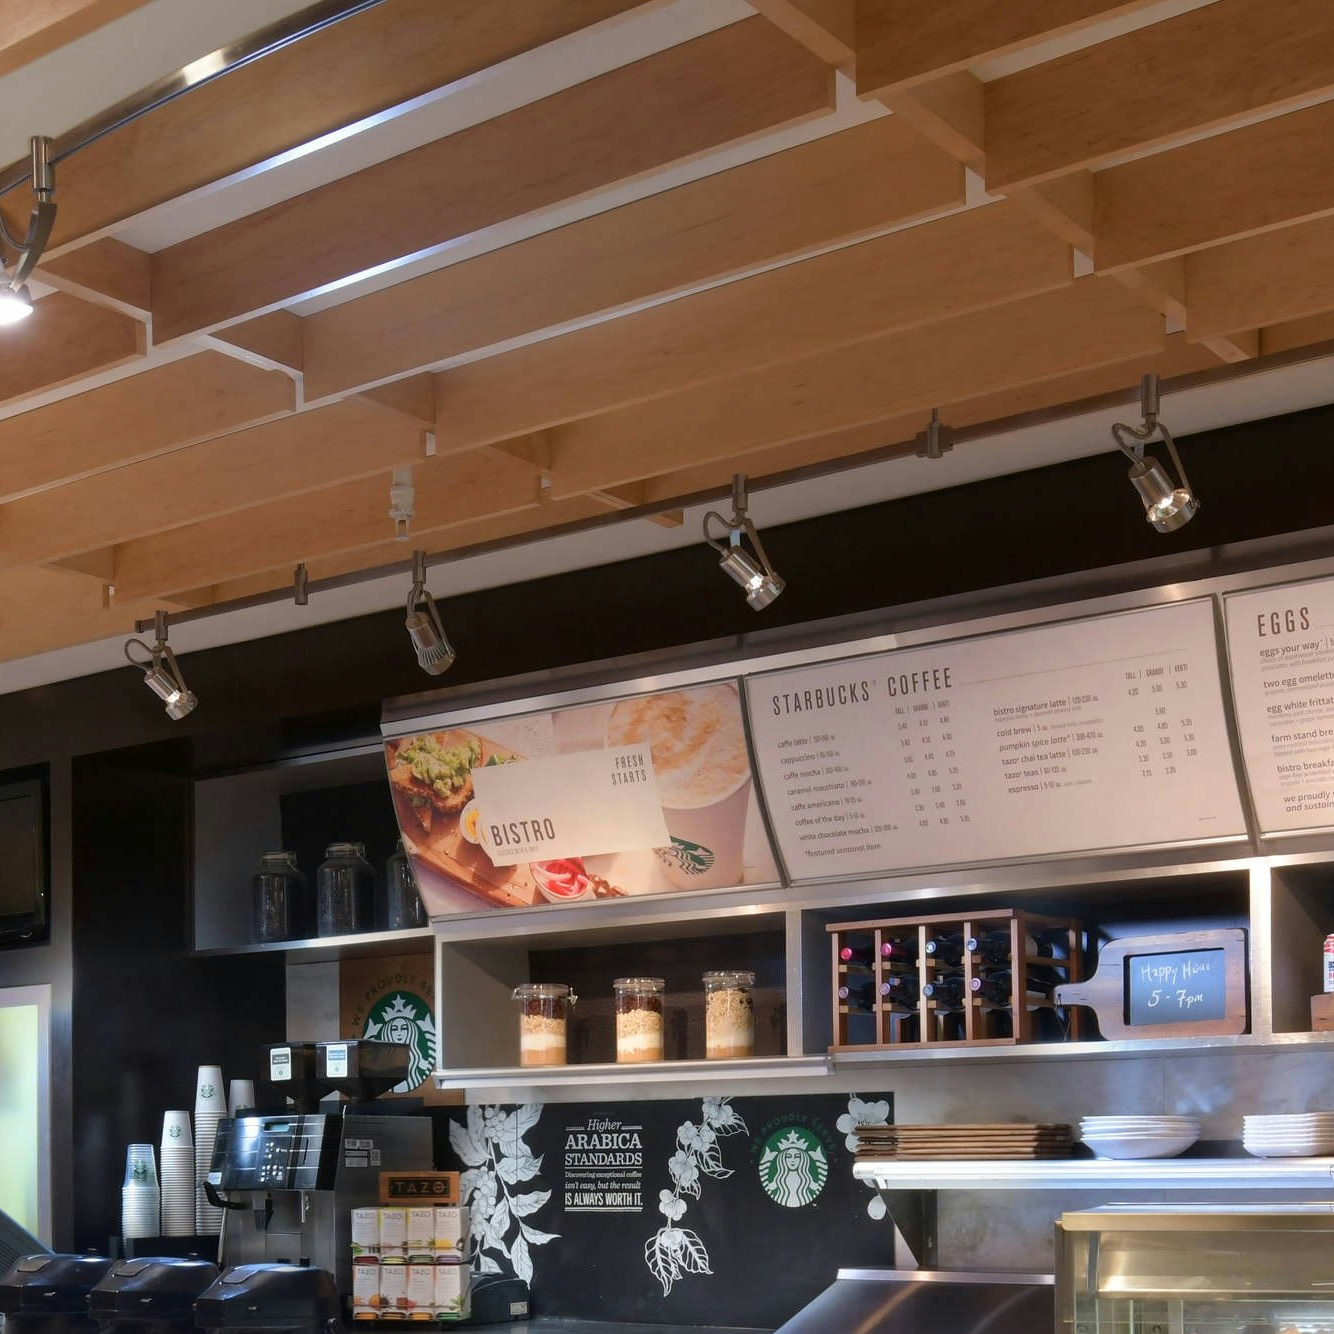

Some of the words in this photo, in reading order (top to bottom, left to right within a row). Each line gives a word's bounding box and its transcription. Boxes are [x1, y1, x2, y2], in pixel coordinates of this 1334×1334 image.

[1257, 607, 1310, 637] EGGS
[1259, 647, 1280, 658] eggs
[1281, 643, 1301, 656] your
[1263, 679, 1280, 689] two
[1281, 677, 1297, 688] egg
[772, 681, 870, 716] STARBUCKS
[887, 668, 952, 697] COFFEE
[993, 706, 1014, 717] bistro
[1015, 701, 1048, 716] signature
[1049, 698, 1067, 709] latte
[1267, 703, 1283, 714] egg
[1284, 698, 1308, 710] white
[997, 728, 1012, 738] cold
[1014, 725, 1032, 735] brew
[1271, 732, 1292, 743] farm
[1293, 729, 1318, 741] stand
[614, 753, 644, 769] FRESH
[1277, 763, 1302, 774] bistro
[611, 769, 647, 786] STARTS
[1283, 796, 1296, 804] we
[1298, 789, 1331, 803] proudly
[1285, 803, 1303, 813] and
[491, 818, 556, 847] BISTRO
[1141, 964, 1178, 985] Happy
[1147, 989, 1162, 1007] 5
[587, 1118, 622, 1132] Higher
[564, 1133, 643, 1149] ARABICA
[564, 1152, 643, 1166] STANDARDS
[626, 1170, 642, 1178] coffee
[395, 1181, 444, 1193] TAZO
[597, 1180, 608, 1189] but
[610, 1180, 620, 1189] the
[621, 1180, 641, 1189] result
[564, 1192, 572, 1205] IS
[573, 1192, 604, 1205] ALWAYS
[605, 1192, 632, 1205] WORTH
[634, 1192, 643, 1205] IT.
